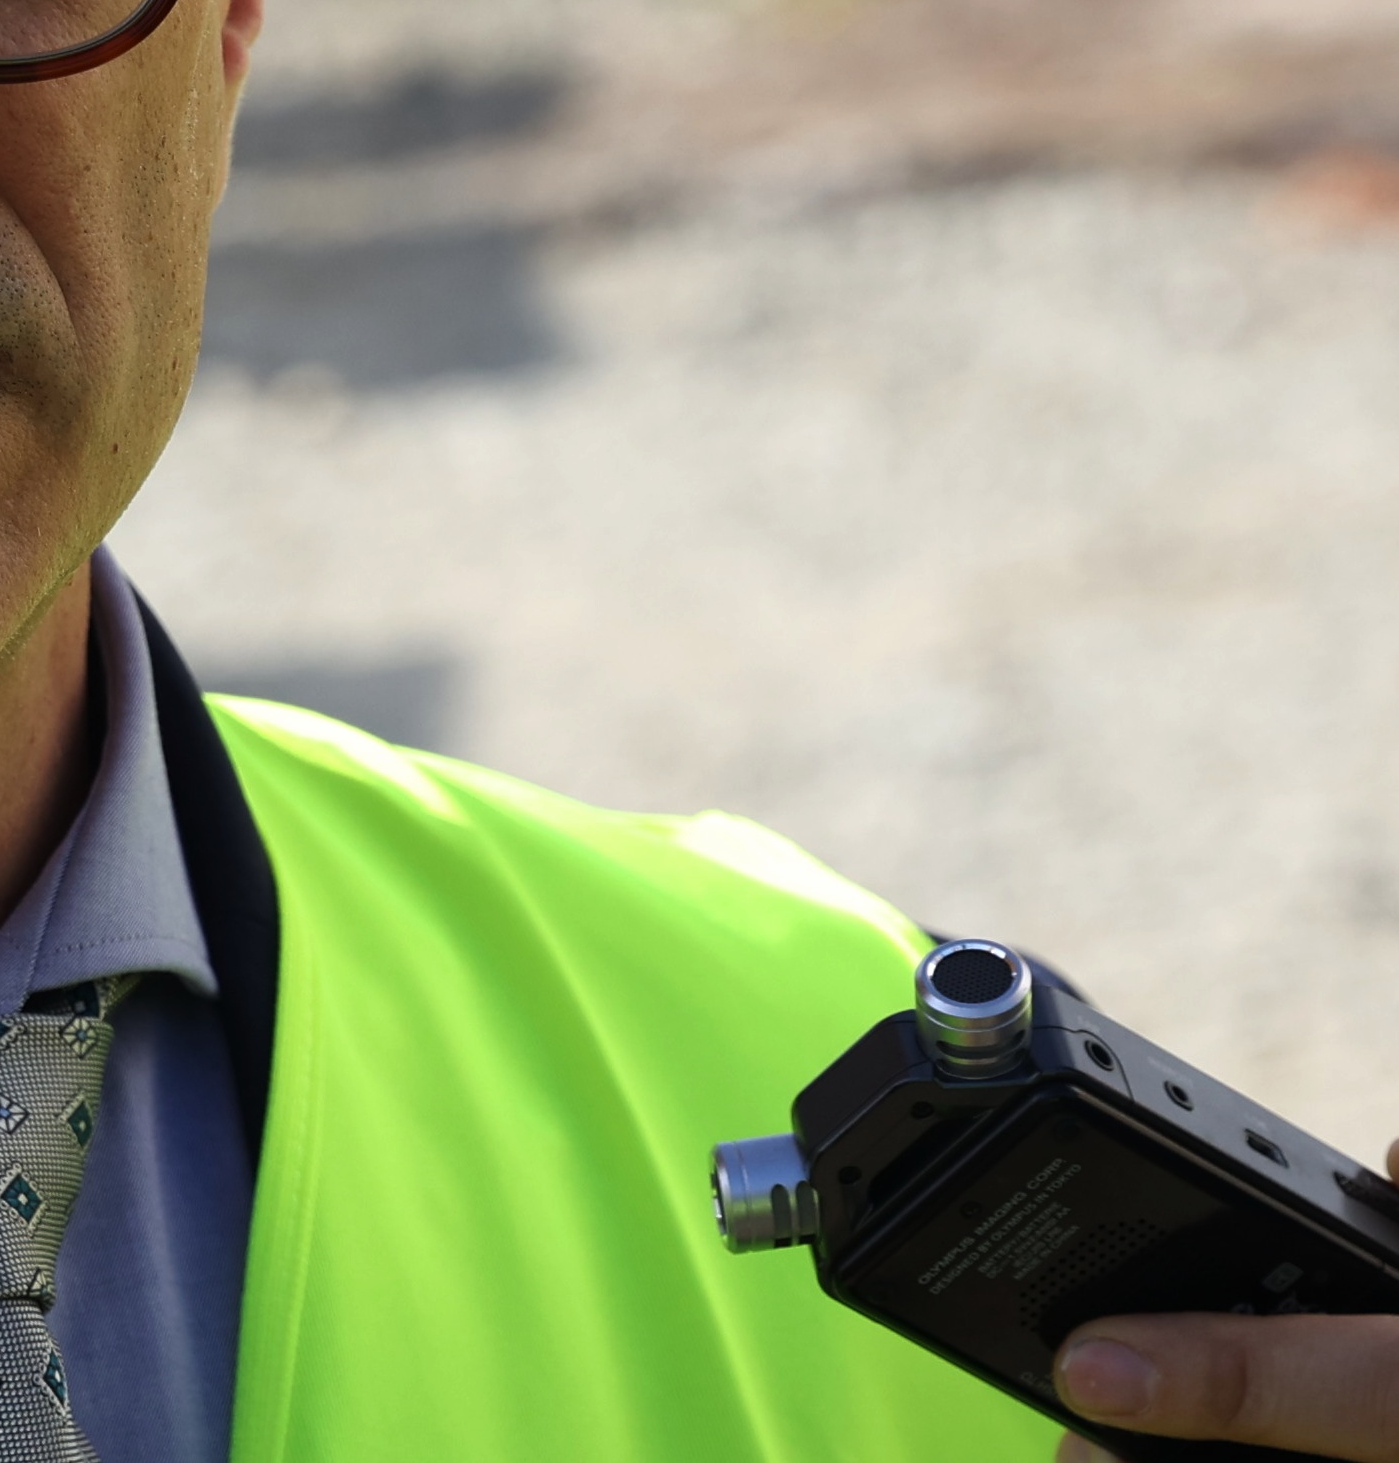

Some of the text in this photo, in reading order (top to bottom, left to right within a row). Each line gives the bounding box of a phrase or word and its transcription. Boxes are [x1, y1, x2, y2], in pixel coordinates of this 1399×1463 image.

[918, 1236, 975, 1284] OLYMPUS
[974, 1191, 1027, 1236] IMAGING
[991, 1203, 1037, 1241] OLYMPUS
[1047, 1164, 1081, 1192] TOKYO
